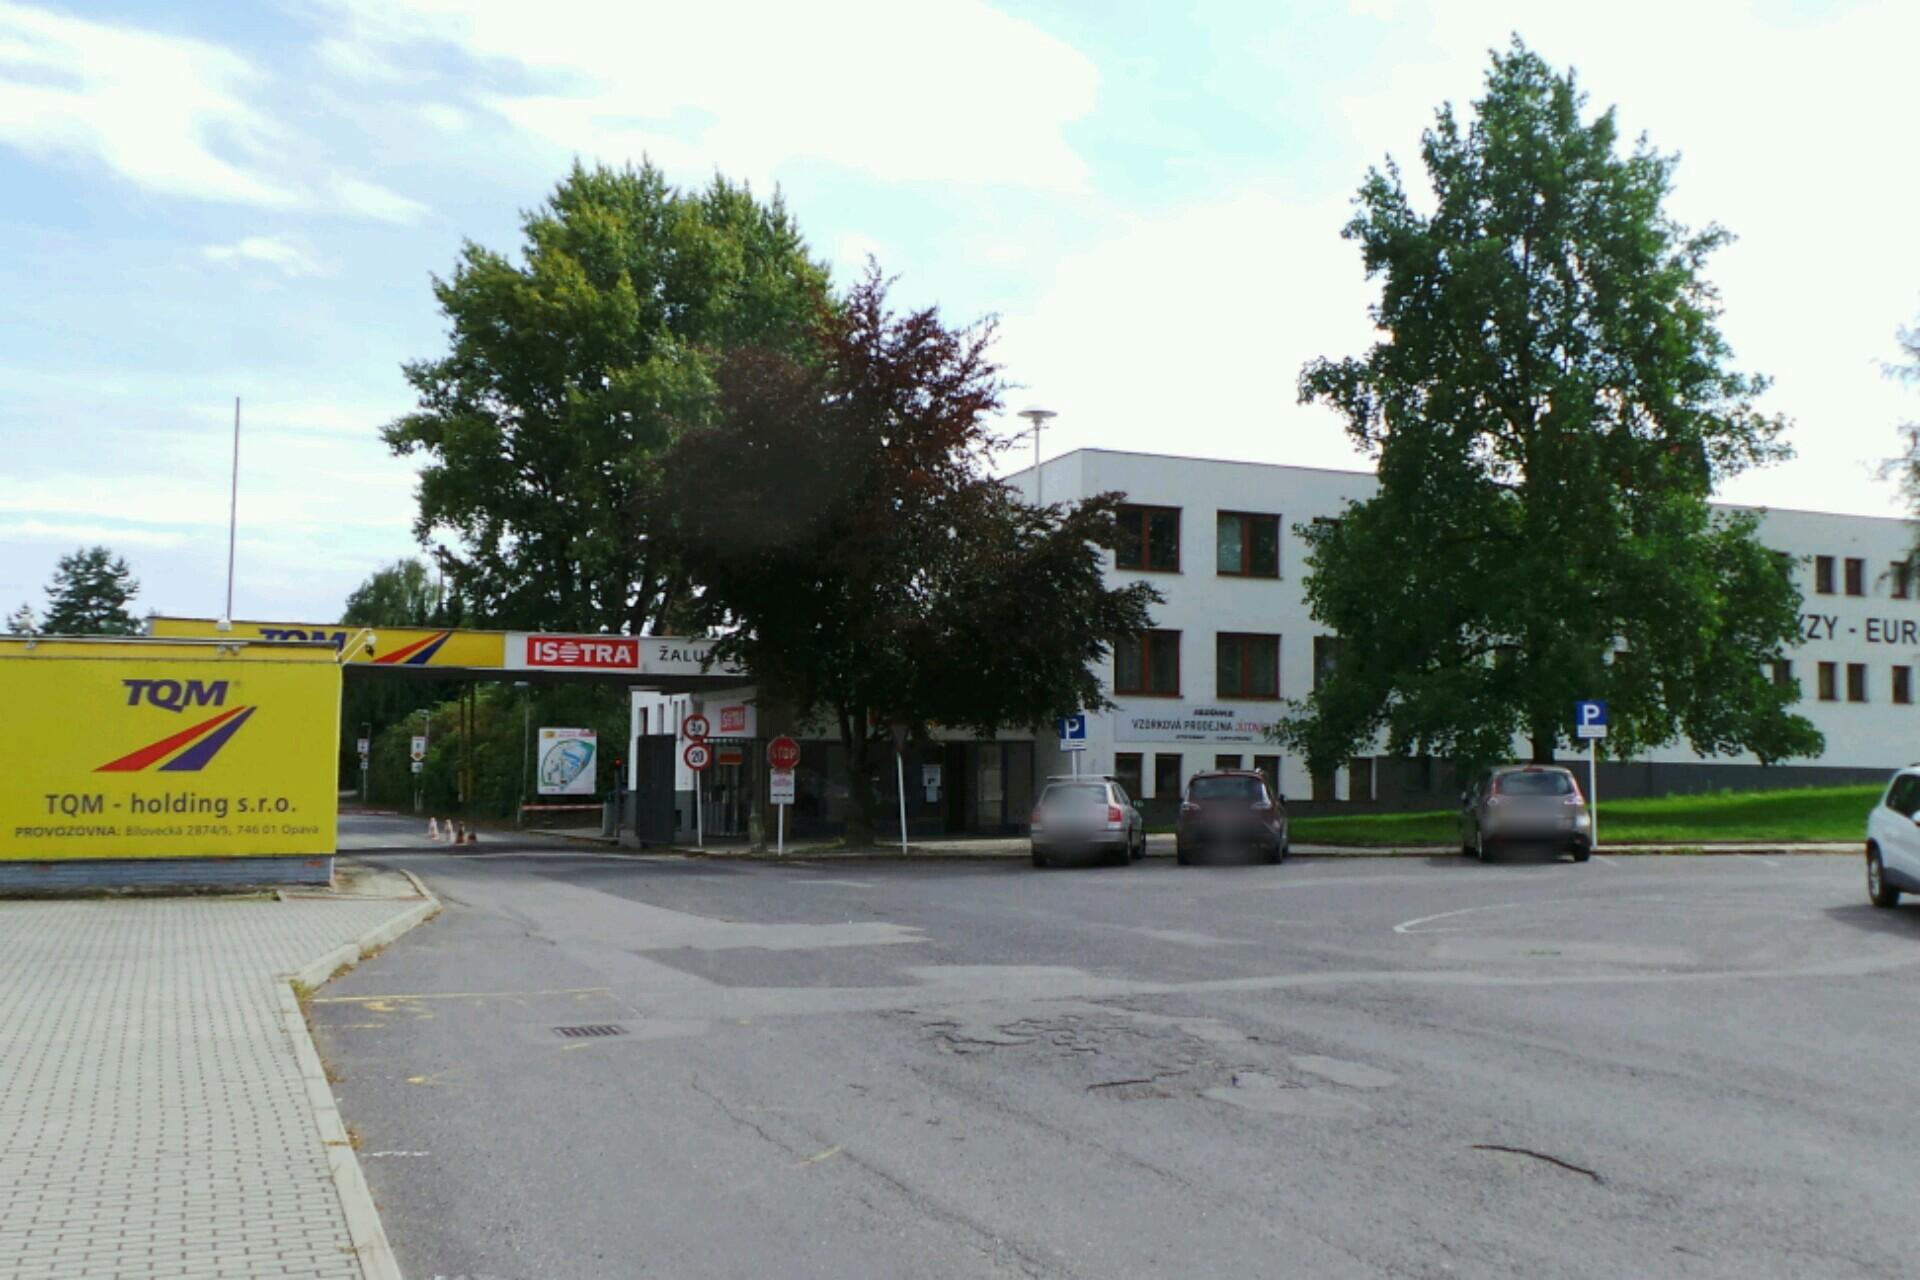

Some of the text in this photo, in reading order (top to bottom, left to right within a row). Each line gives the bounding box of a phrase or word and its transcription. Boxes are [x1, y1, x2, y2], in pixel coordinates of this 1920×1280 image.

[534, 641, 632, 664] ISOTRA
[122, 679, 229, 713] TQM
[1132, 716, 1182, 730] VZORKOVÁ
[1184, 719, 1233, 732] PRODEJNA
[1583, 704, 1600, 725] P
[1065, 718, 1080, 740] P
[691, 750, 704, 763] 20
[772, 747, 797, 760] STOP
[45, 793, 104, 816] TQM
[131, 793, 228, 818] holding
[237, 796, 297, 814] s.r.o.
[281, 824, 319, 836] Opava
